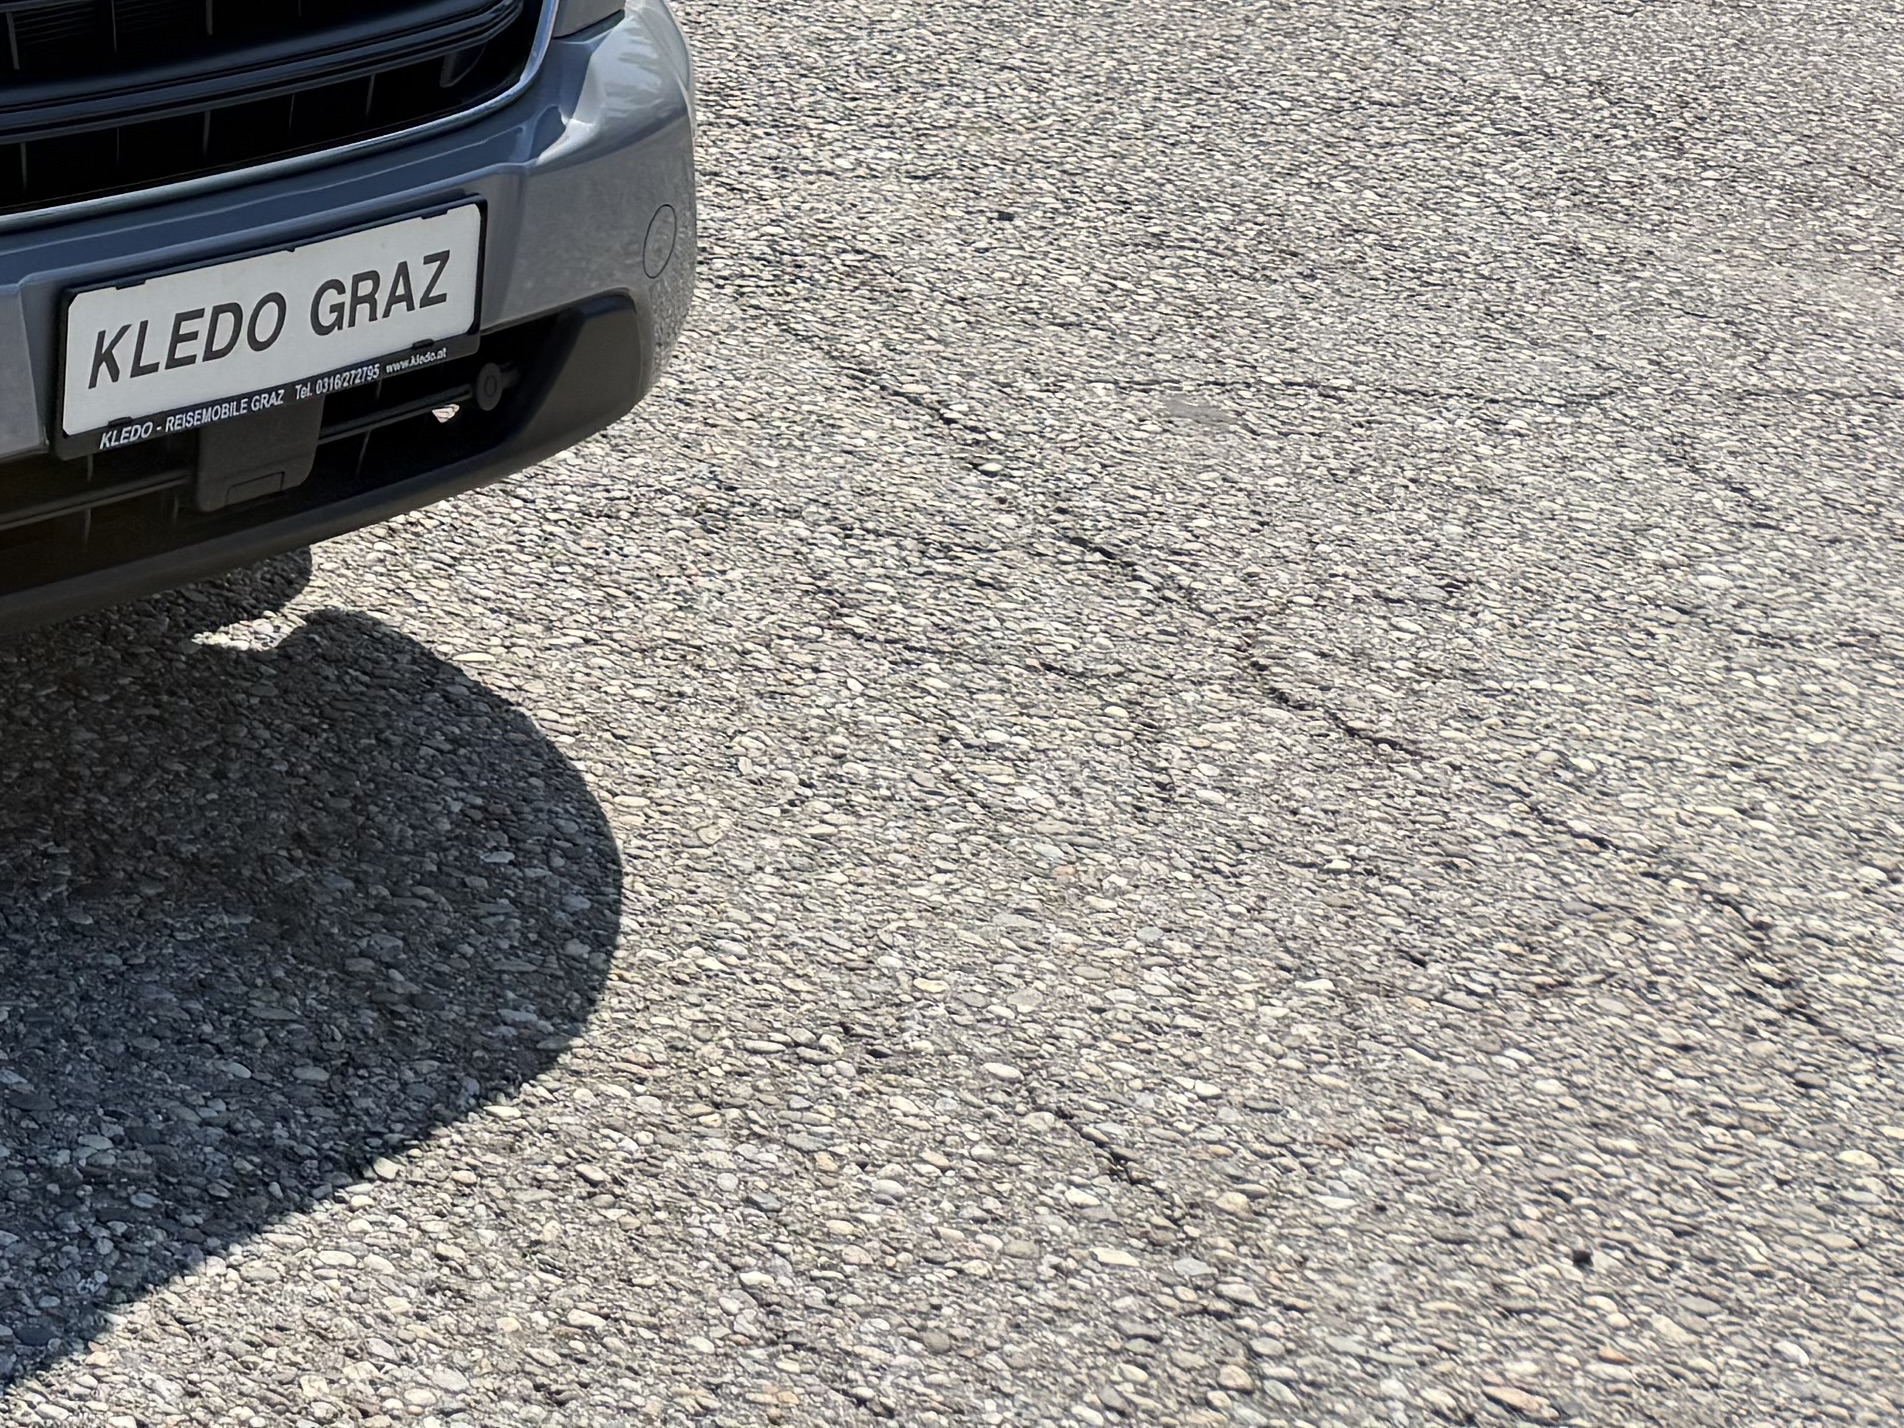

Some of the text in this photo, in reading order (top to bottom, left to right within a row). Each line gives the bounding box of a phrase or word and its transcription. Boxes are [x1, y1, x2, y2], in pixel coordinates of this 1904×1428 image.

[88, 250, 451, 389] KLEDO GRAZ
[99, 422, 153, 450] KLEDO
[165, 398, 249, 433] REISEMOBILE
[251, 389, 285, 411] GRAZ
[295, 382, 313, 400] Tel.
